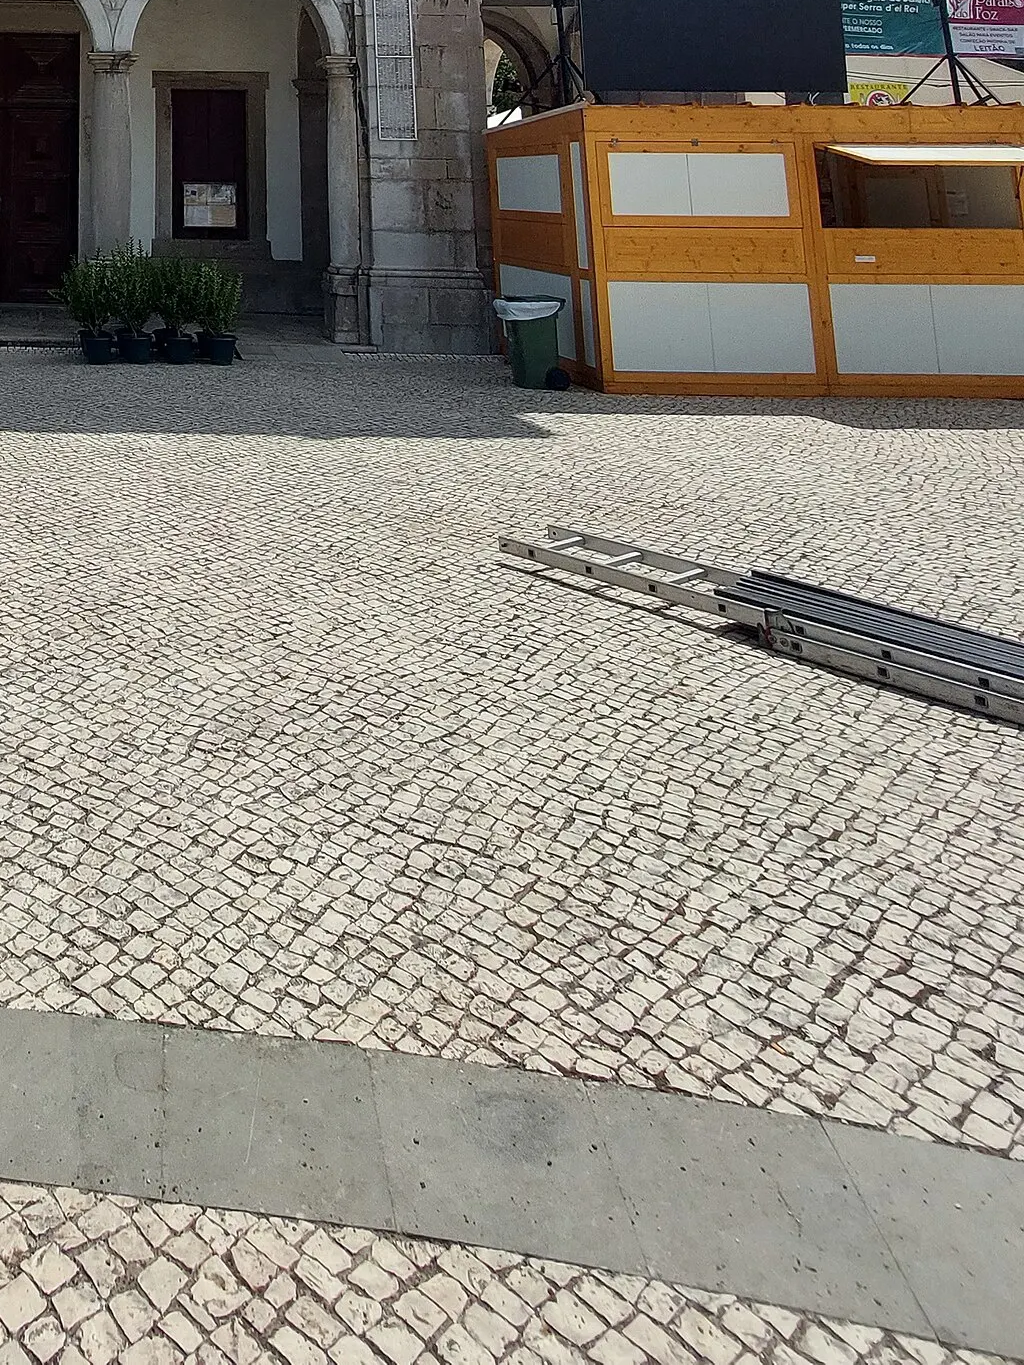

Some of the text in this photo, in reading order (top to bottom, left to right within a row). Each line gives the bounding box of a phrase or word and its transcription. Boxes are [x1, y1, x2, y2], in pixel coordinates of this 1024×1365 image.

[858, 2, 883, 11] Serra
[903, 4, 919, 13] Rei
[859, 18, 883, 26] NOSSO
[973, 43, 1006, 52] LEITÃO
